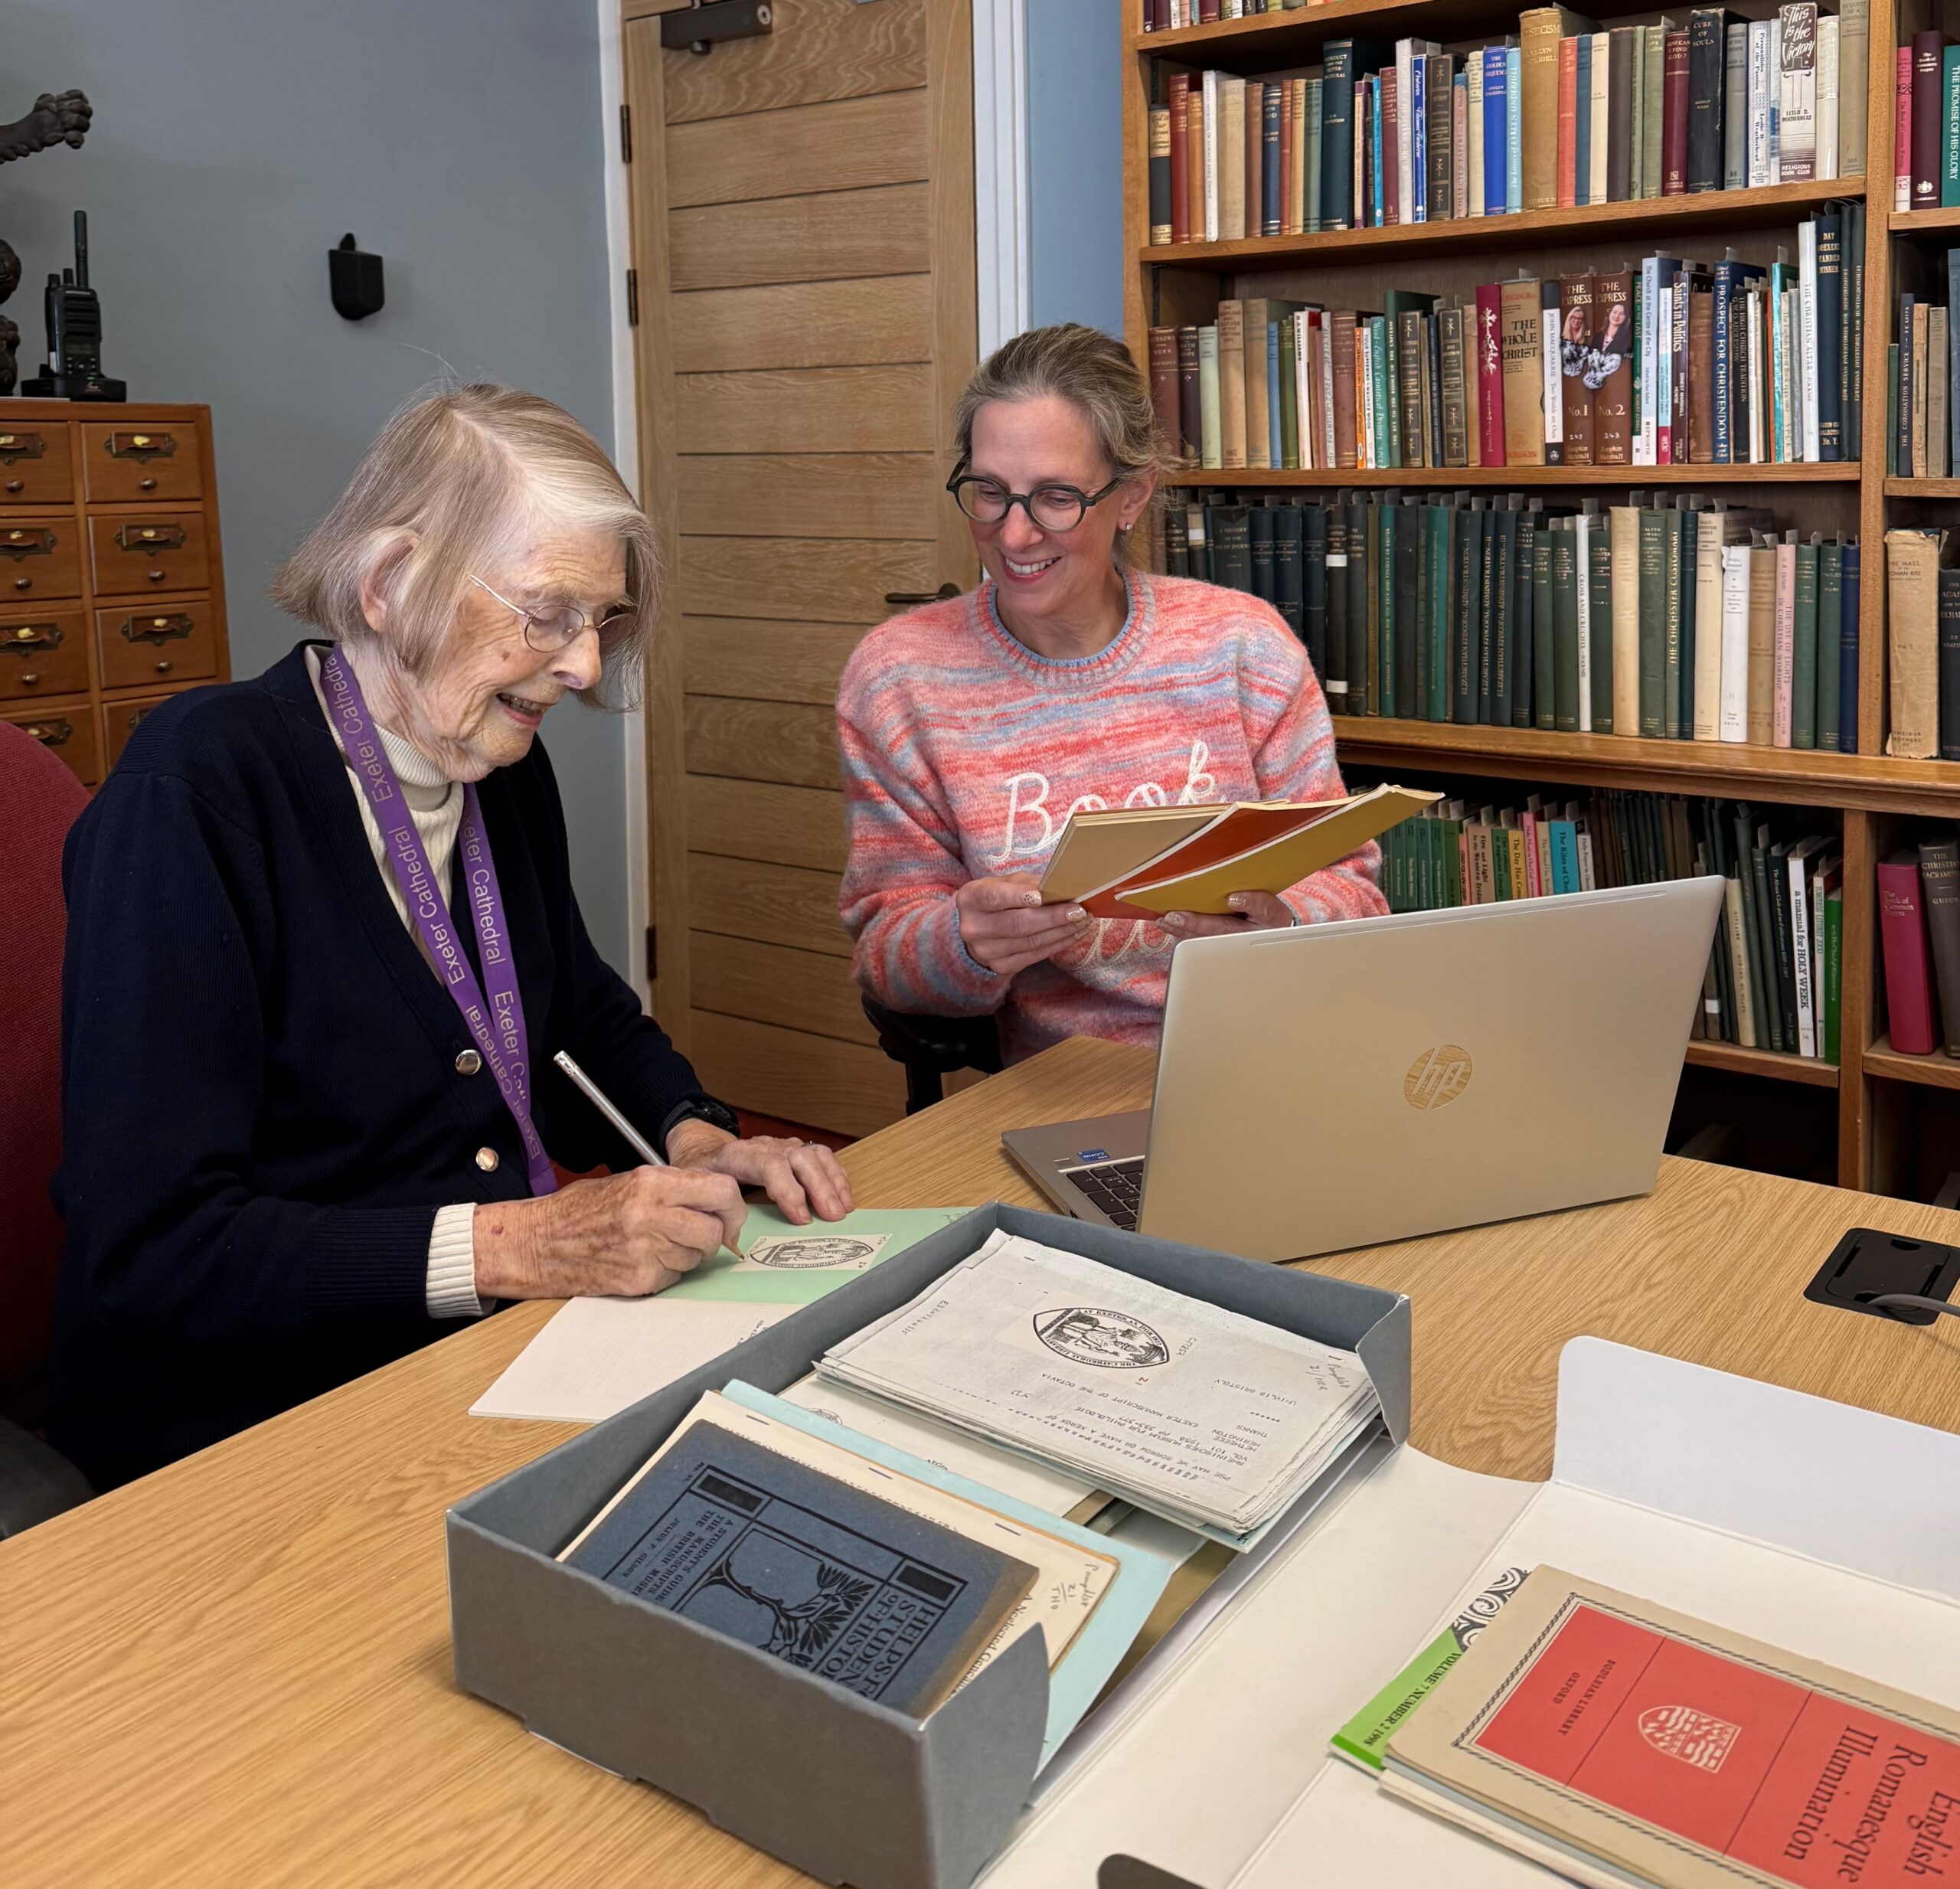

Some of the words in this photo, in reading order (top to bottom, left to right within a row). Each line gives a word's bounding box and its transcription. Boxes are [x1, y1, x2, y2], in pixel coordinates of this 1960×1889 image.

[1785, 5, 1809, 25] This
[1692, 39, 1715, 47] SOULS
[1785, 24, 1795, 39] is
[1794, 25, 1811, 42] the
[1782, 40, 1815, 66] Victory
[1952, 65, 1960, 84] THE
[1511, 67, 1519, 112] UNDERHILL
[1950, 84, 1959, 122] PROMISE
[1950, 123, 1959, 134] OF
[1949, 135, 1958, 149] HIS
[1949, 151, 1958, 180] GLORY
[1566, 284, 1586, 294] THE
[1595, 292, 1627, 304] EXPRESS
[1600, 282, 1620, 292] THE
[1672, 282, 1687, 309] Saints
[1562, 293, 1592, 306] EXPRESS
[1717, 285, 1726, 335] PROSPECT
[1511, 319, 1537, 330] THE
[1672, 310, 1686, 320] in
[1805, 301, 1813, 343] CHRISTIAN
[1501, 331, 1537, 345] WHOLE
[1672, 320, 1686, 352] Politics
[1501, 347, 1538, 361] CHRIST
[1717, 338, 1726, 359] FOR
[1805, 346, 1814, 371] ALTAR
[1901, 351, 1909, 381] SERVICE
[1739, 364, 1747, 402] TRADITION
[1615, 404, 1625, 416] 2
[1717, 363, 1726, 440] CHRISTENDOM
[1668, 531, 1678, 587] CUSTOMARY
[1669, 589, 1678, 645] CHICHESTER
[1669, 647, 1678, 665] THE
[387, 825, 437, 918] Cathedral
[472, 869, 506, 966] Cathedral
[1794, 899, 1805, 933] manual
[1795, 933, 1804, 948] for
[430, 923, 466, 985] Exeter
[1797, 949, 1808, 976] HOLY
[1798, 976, 1810, 1009] WEEK
[495, 991, 520, 1056] Exeter
[466, 1005, 513, 1095] Cathedral
[1403, 1044, 1472, 1110] hp
[1046, 1338, 1070, 1356] LIBRARY
[1072, 1354, 1118, 1367] CATHEDRAL
[1042, 1373, 1076, 1387] OCTAVIA
[1075, 1406, 1126, 1427] PHILOLOGIE
[1112, 1397, 1164, 1417] MANUSCRIPT
[1060, 1419, 1085, 1431] XEROX
[1129, 1425, 1146, 1433] FUR
[1166, 1414, 1200, 1428] EXETER
[1236, 1425, 1269, 1438] THANKS
[1102, 1432, 1122, 1443] HAVE
[1149, 1432, 1182, 1446] MUSEUM
[1178, 1436, 1200, 1446] 1958
[1212, 1429, 1261, 1448] HERINGTON
[1139, 1446, 1173, 1462] BORROW
[1185, 1443, 1244, 1466] RHEINISCHES
[1233, 1453, 1248, 1462] VOL
[1192, 1465, 1210, 1473] MAY
[1213, 1472, 1231, 1481] PSE
[695, 1510, 715, 1528] THE
[705, 1515, 726, 1533] THE
[655, 1518, 681, 1543] JULIUS
[661, 1531, 696, 1565] BRITISH
[686, 1528, 727, 1574] STUDENT'S
[622, 1552, 648, 1578] GILSON
[648, 1535, 705, 1595] MANUSCRIPTS
[655, 1575, 684, 1603] GUIDE
[1552, 1672, 1581, 1705] OXFORD
[1582, 1658, 1617, 1701] BODLEIAN
[1387, 1687, 1426, 1725] NUMBER
[1558, 1698, 1589, 1737] LIBRARY
[1783, 1725, 1879, 1861] Illumination
[1832, 1744, 1929, 1884] Romanesque
[1903, 1790, 1960, 1876] English
